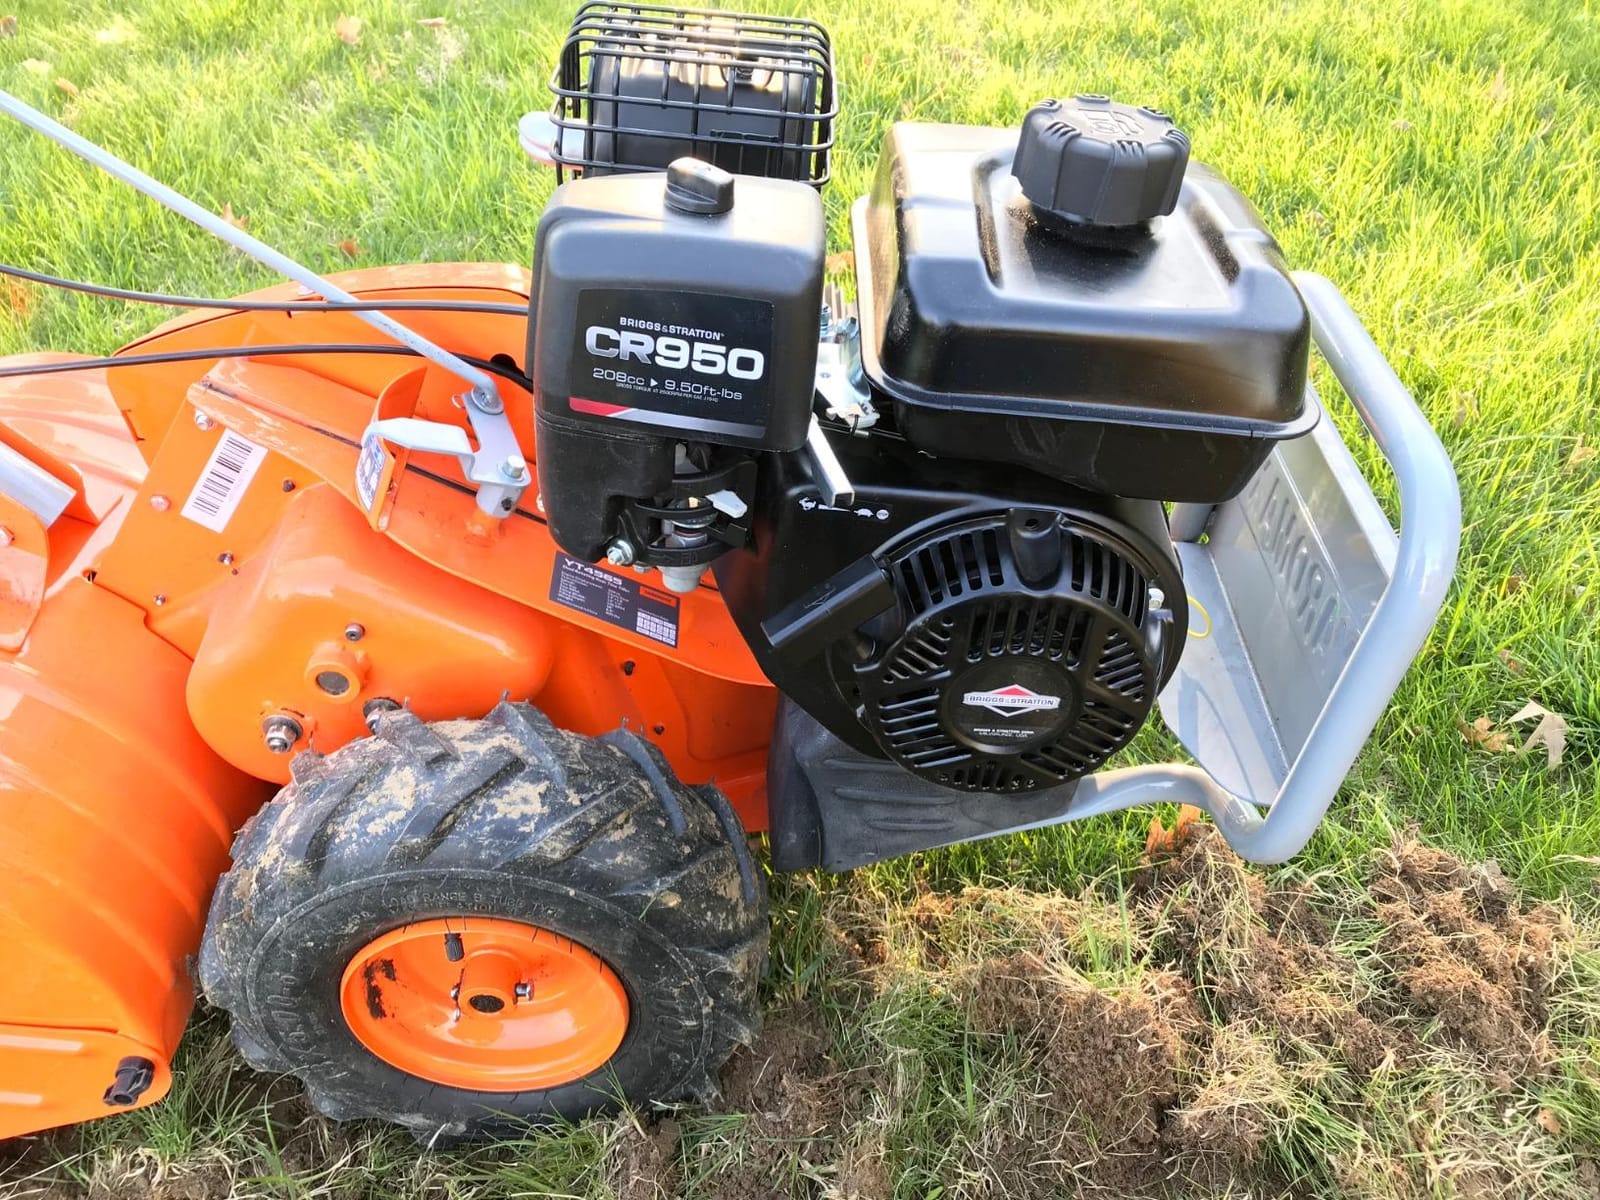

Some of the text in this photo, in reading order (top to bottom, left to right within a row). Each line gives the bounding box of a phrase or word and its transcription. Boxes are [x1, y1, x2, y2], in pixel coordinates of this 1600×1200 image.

[585, 325, 765, 381] CR950
[592, 367, 743, 401] 208cc 9.50ft-lbs
